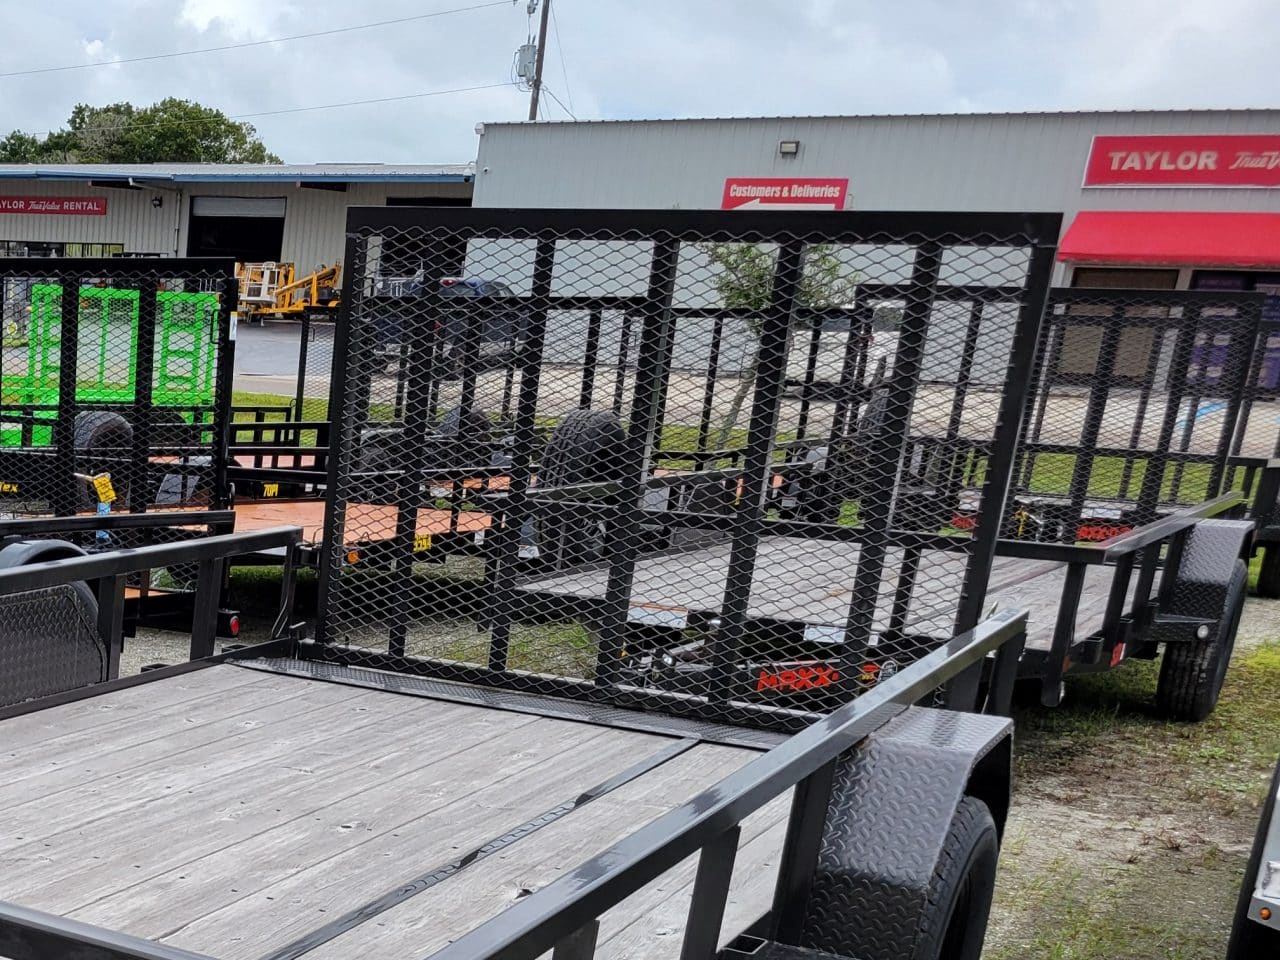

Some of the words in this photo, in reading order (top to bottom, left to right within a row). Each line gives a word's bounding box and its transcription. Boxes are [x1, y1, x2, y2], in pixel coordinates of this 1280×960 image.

[1108, 152, 1218, 170] TAYLOR
[1229, 151, 1280, 170] TrueV
[729, 184, 780, 197] Customers
[781, 187, 789, 197] &
[791, 184, 841, 198] Deliveries
